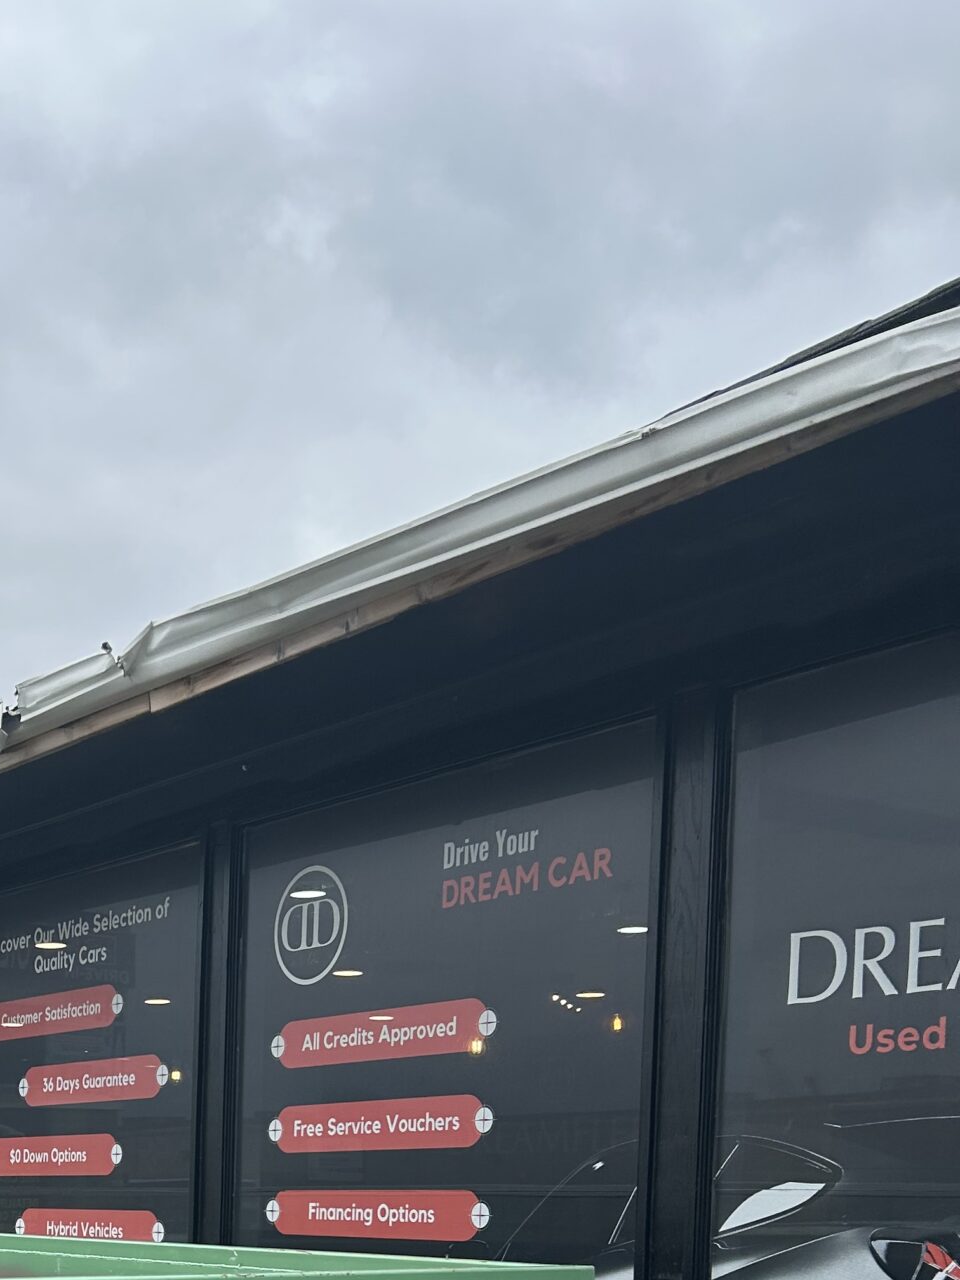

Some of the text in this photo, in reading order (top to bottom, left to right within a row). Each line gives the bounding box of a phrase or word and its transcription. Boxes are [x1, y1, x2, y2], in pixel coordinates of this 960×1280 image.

[443, 828, 539, 870] Drive Your
[442, 847, 613, 909] DREAM CAR
[33, 927, 55, 945] Our
[58, 917, 89, 941] Wide
[93, 905, 152, 932] Selection
[155, 896, 170, 919] of
[34, 950, 75, 974] Quality
[78, 945, 107, 965] Cars
[787, 917, 960, 1005] DRE
[1, 1001, 101, 1027] Customer Satisfaction
[301, 1016, 457, 1051] All Credits Approved
[849, 1016, 947, 1055] Used
[43, 1073, 136, 1094] 36 Days Guarantee
[293, 1112, 460, 1137] Free Service Vouchers
[9, 1147, 87, 1166] $0 Down Options
[308, 1202, 435, 1226] Financing Options
[46, 1220, 123, 1238] Hybrid Vehicles
